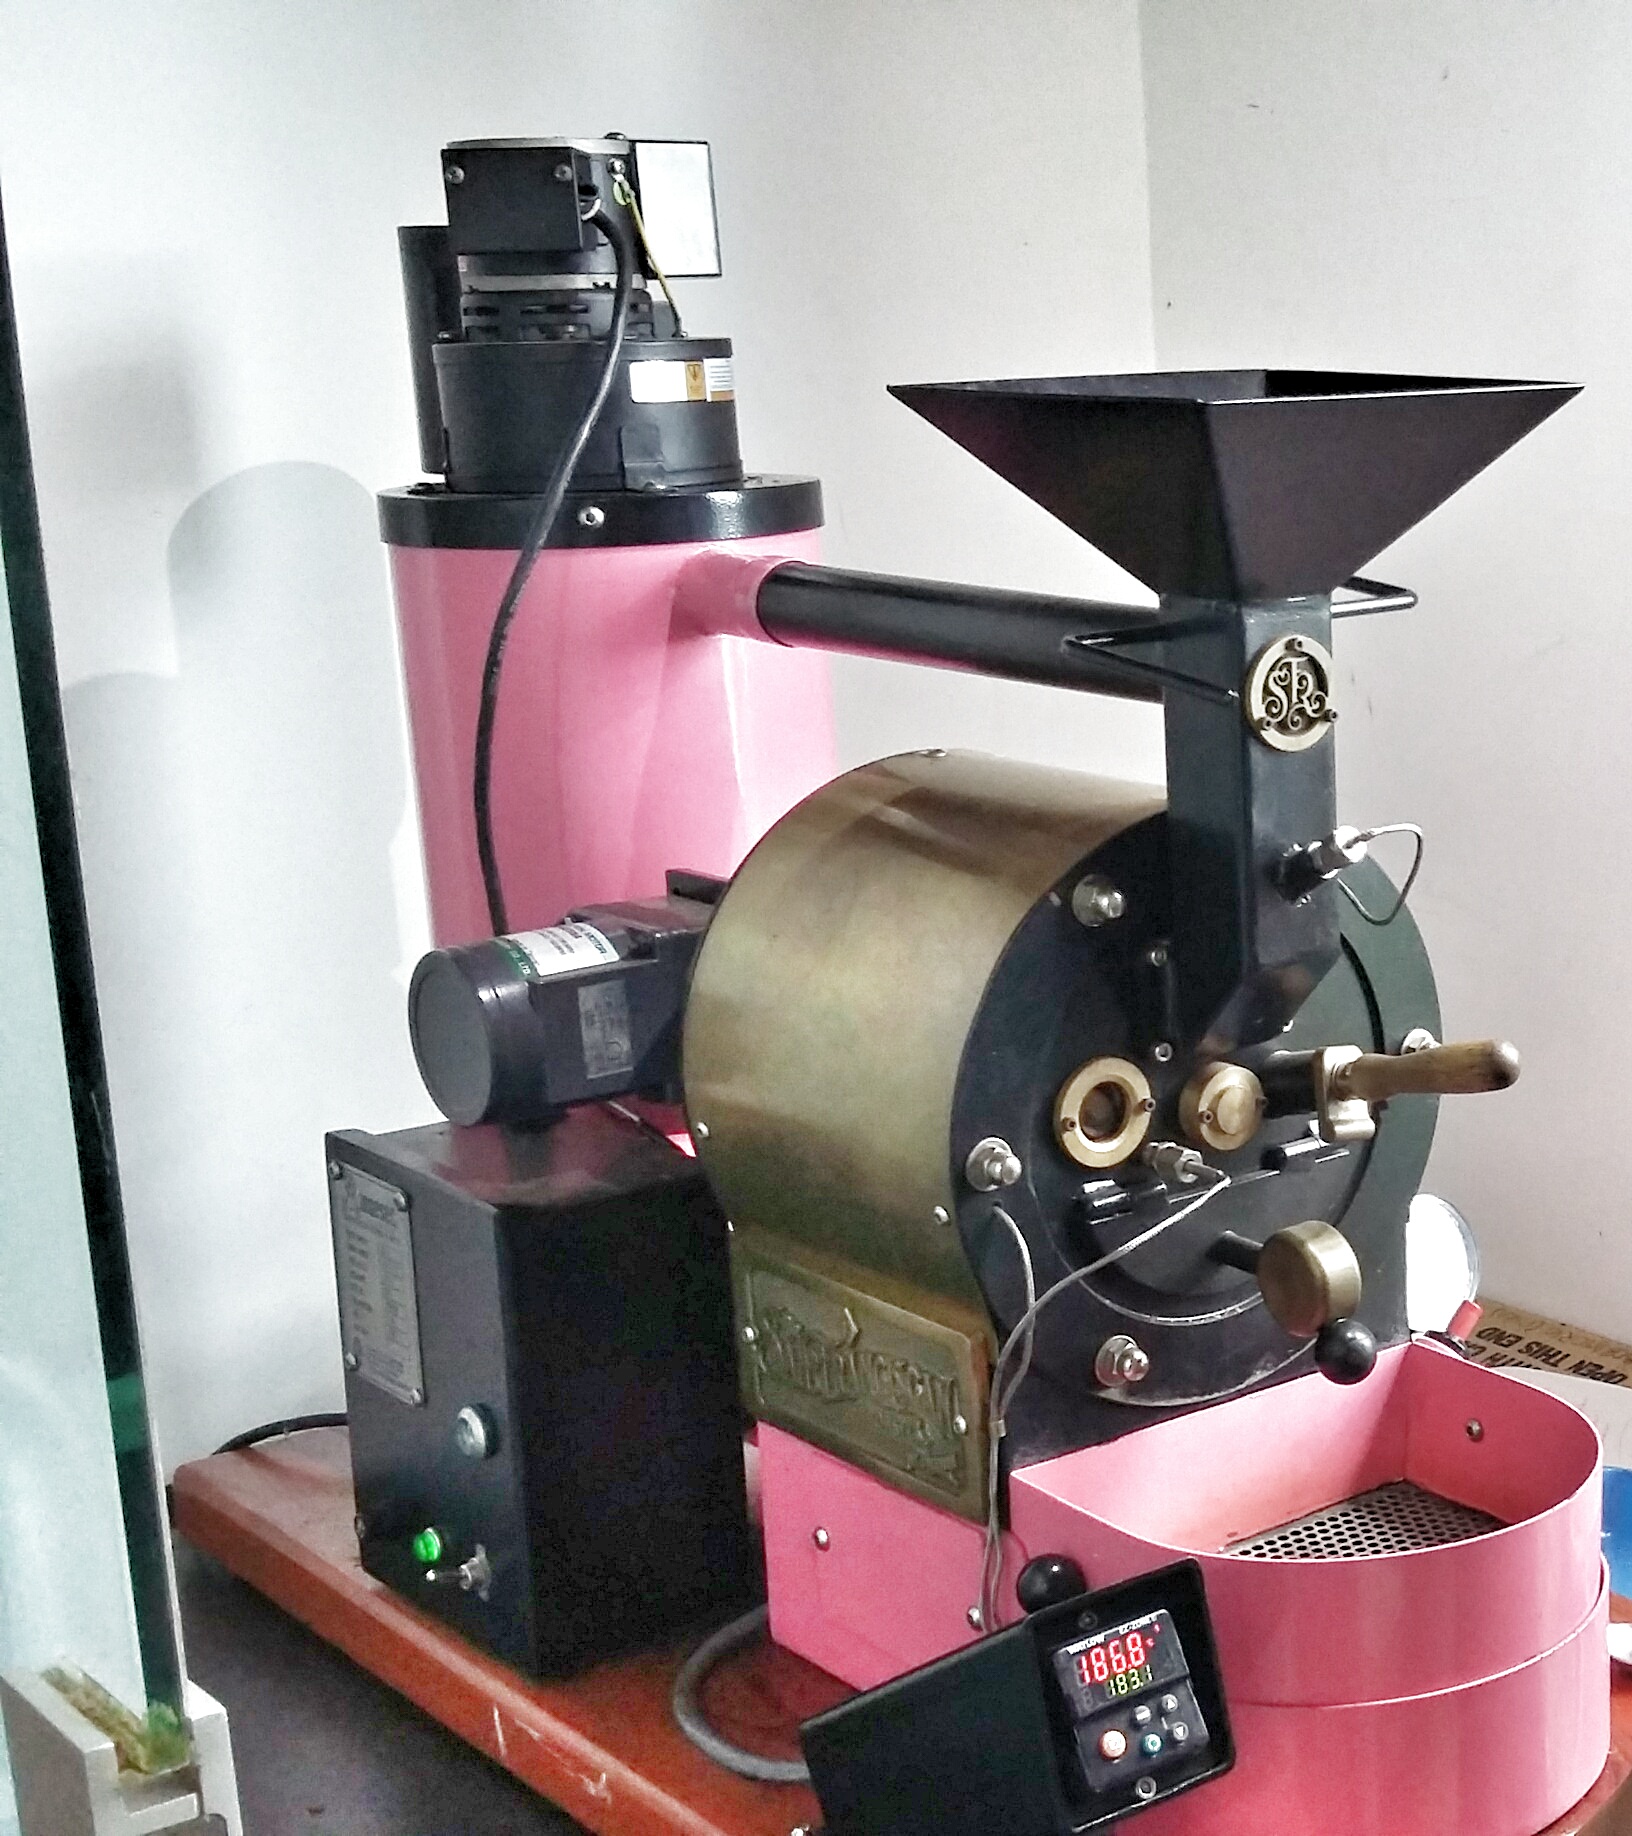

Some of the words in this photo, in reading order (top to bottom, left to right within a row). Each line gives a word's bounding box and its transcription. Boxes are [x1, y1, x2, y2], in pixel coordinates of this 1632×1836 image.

[1476, 1326, 1524, 1348] END
[1518, 1340, 1571, 1367] THIS
[1567, 1359, 1628, 1384] OPEN
[1080, 1632, 1146, 1684] 186.8
[1109, 1663, 1153, 1696] 183.1
